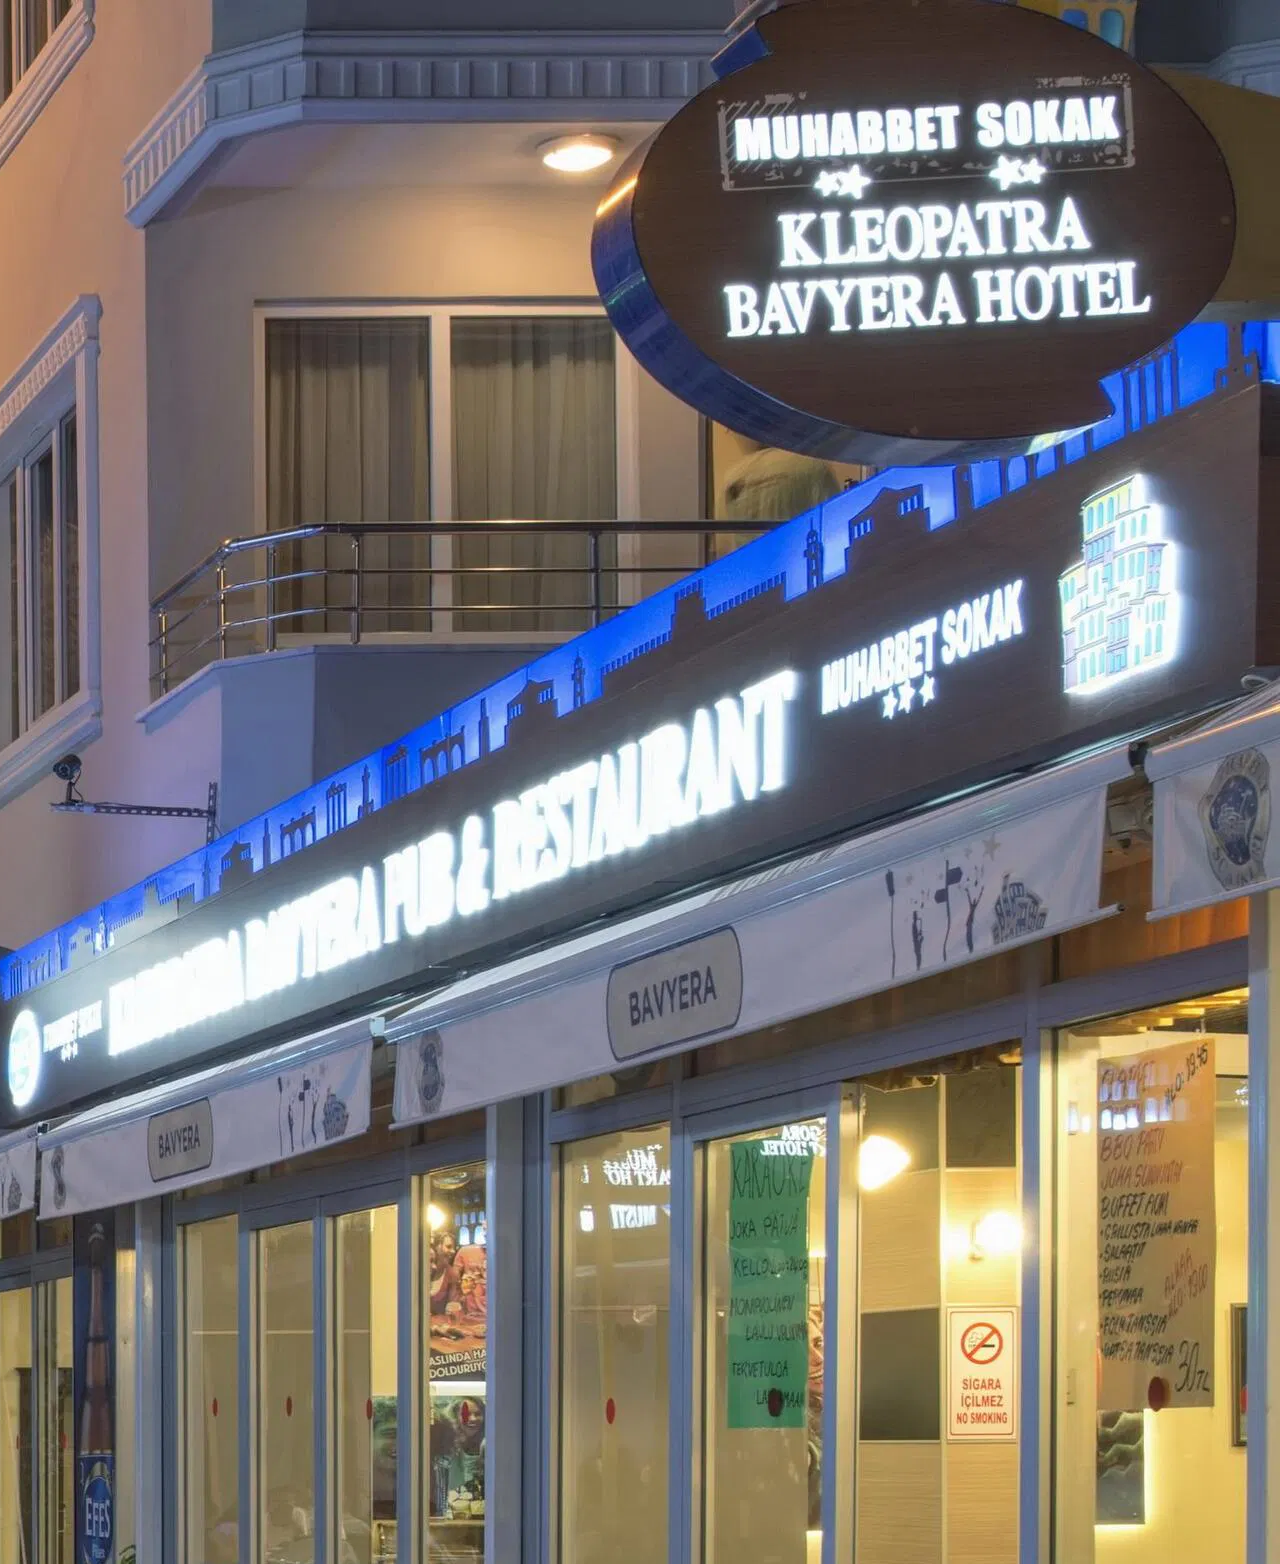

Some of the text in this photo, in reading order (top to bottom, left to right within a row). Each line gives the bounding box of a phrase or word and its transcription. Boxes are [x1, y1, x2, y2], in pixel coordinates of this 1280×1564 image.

[734, 96, 1120, 162] MUHABBET SOKAK
[777, 196, 1091, 268] KLEOPATRA
[723, 261, 1151, 338] BAVYERA HOTEL
[821, 578, 1023, 715] MUHABBET SOKAK
[383, 832, 455, 943] PUB
[456, 814, 490, 916] &
[492, 669, 797, 900] RESTAURANT
[629, 965, 717, 1027] BAVYERA
[158, 1123, 201, 1159] BAVYERA
[430, 1352, 471, 1366] ASLINDA
[962, 1376, 1001, 1390] SİGARA
[956, 1412, 1008, 1424] NO SMOKING
[961, 1393, 1003, 1410] İÇİLMEZ
[86, 1498, 110, 1538] EFES
